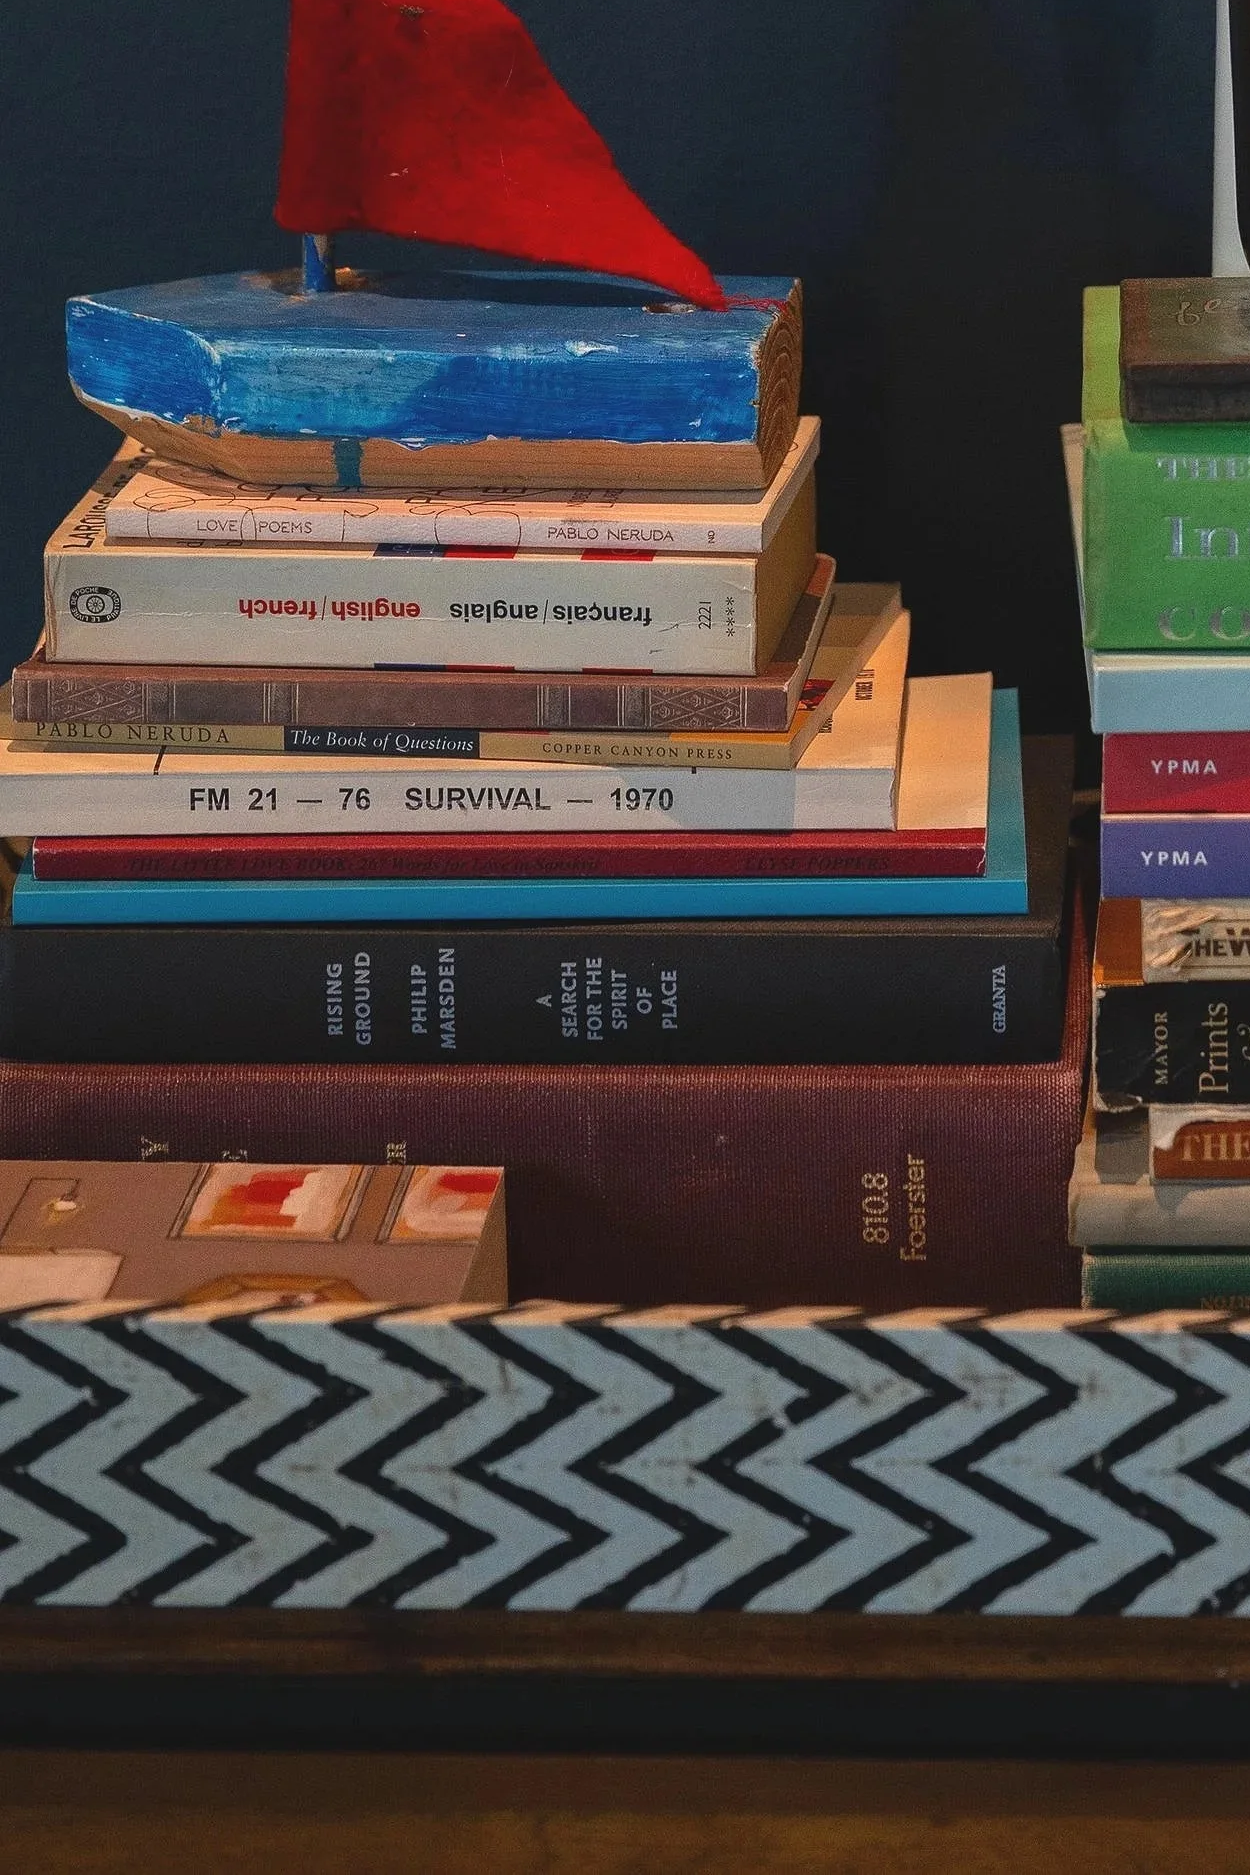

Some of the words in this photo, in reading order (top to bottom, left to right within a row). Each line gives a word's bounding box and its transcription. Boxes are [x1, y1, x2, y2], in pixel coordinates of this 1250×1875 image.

[197, 519, 239, 533] LOVE
[258, 521, 313, 535] POEMS
[547, 527, 599, 541] PABLO
[607, 528, 675, 543] NERUDA
[76, 586, 99, 596] POCHE
[238, 599, 317, 621] french
[332, 597, 421, 621] english
[450, 600, 539, 624] anglais
[553, 601, 652, 626] français
[35, 722, 113, 739] PABLO
[128, 724, 230, 743] NERUDA
[290, 729, 321, 745] The
[326, 730, 367, 748] Book
[372, 732, 392, 751] of
[393, 731, 474, 753] Questions
[542, 742, 602, 756] COPPER
[611, 744, 679, 759] CANYON
[687, 748, 733, 761] PRESS
[1151, 759, 1218, 775] YPMA
[190, 787, 230, 811] FM
[248, 787, 278, 811] 21
[339, 787, 371, 811] 76
[404, 787, 552, 811] SURVIVAL
[609, 787, 674, 811] 1970
[128, 857, 163, 871] THE
[1141, 850, 1208, 867] YPMA
[586, 957, 602, 1003] THE
[326, 963, 344, 1036] RISING
[354, 951, 372, 1046] GROUND
[411, 964, 428, 1035] PHILIP
[439, 948, 457, 1050] MARSDEN
[536, 994, 552, 1008] A
[561, 961, 578, 1038] SEARCH
[611, 969, 628, 1030] SPIRIT
[636, 987, 653, 1014] OF
[661, 969, 678, 1030] PLACE
[992, 965, 1006, 1033] GRANTA
[586, 1005, 603, 1041] FOR
[1154, 1011, 1169, 1086] MAYOR
[1198, 1001, 1229, 1094] Prints
[862, 1172, 890, 1246] 810.8
